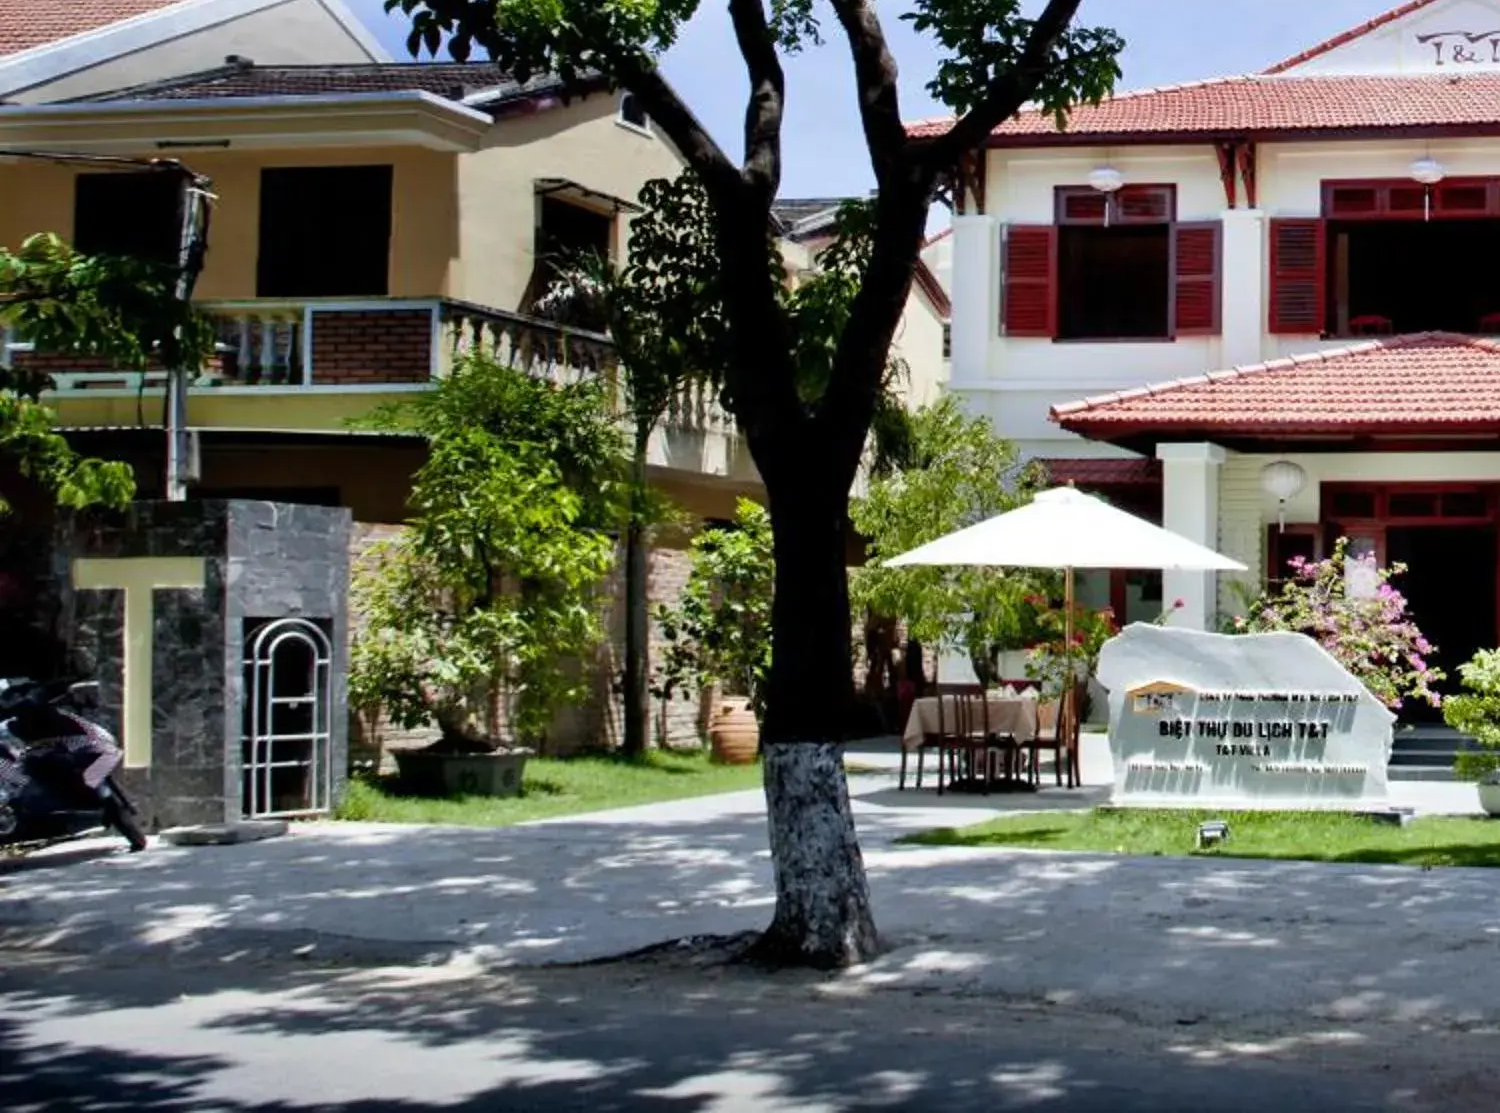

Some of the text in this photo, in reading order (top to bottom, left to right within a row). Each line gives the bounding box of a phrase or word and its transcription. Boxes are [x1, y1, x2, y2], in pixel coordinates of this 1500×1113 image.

[72, 556, 206, 768] T
[1159, 718, 1191, 740] BIỆT
[1233, 722, 1253, 738] DU
[1259, 722, 1293, 741] LỊCH
[1298, 722, 1329, 738] T&T
[1216, 744, 1236, 756] T&T
